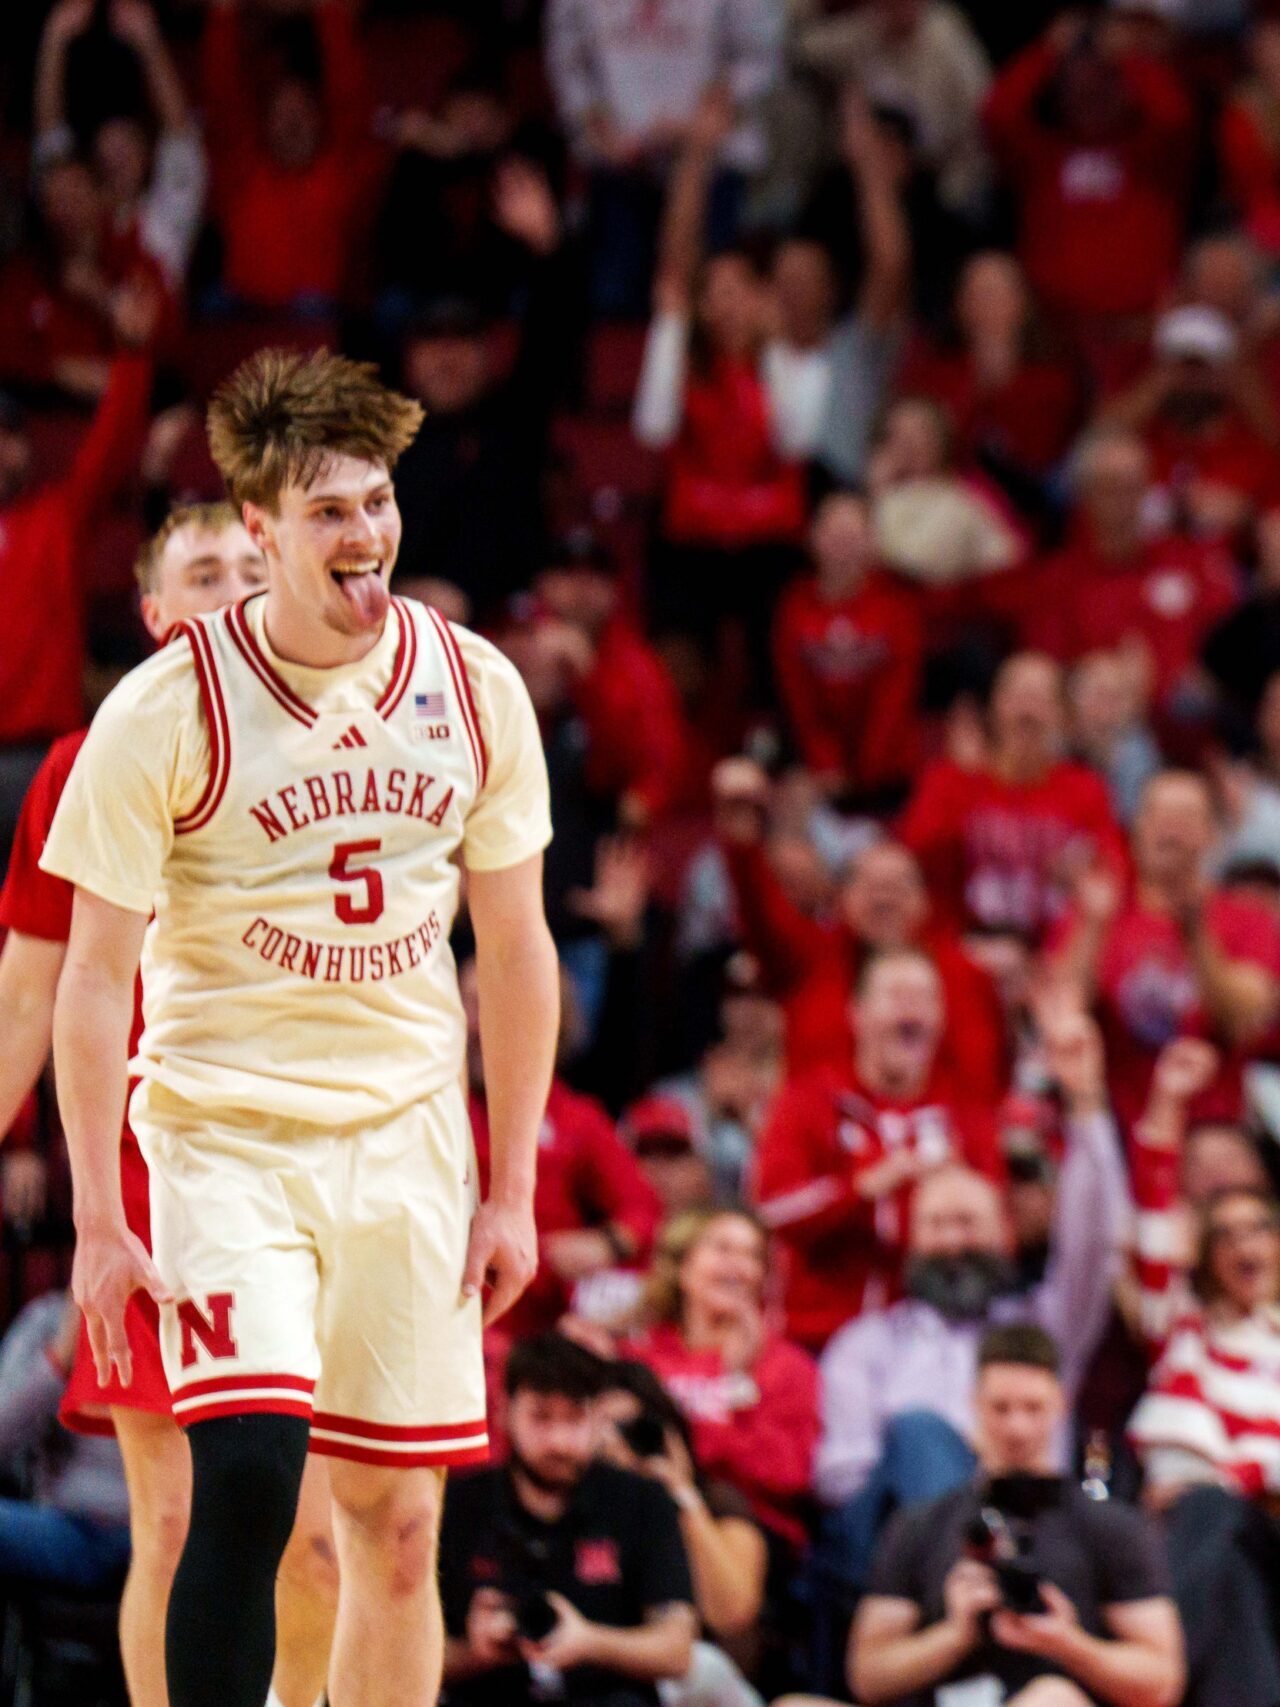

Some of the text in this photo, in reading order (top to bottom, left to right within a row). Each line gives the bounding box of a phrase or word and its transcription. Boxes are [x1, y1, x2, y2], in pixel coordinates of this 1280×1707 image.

[249, 768, 454, 843] NEBRASKA
[328, 838, 385, 925] 5
[242, 910, 441, 983] CORNHUSKERS
[176, 1291, 238, 1371] N
